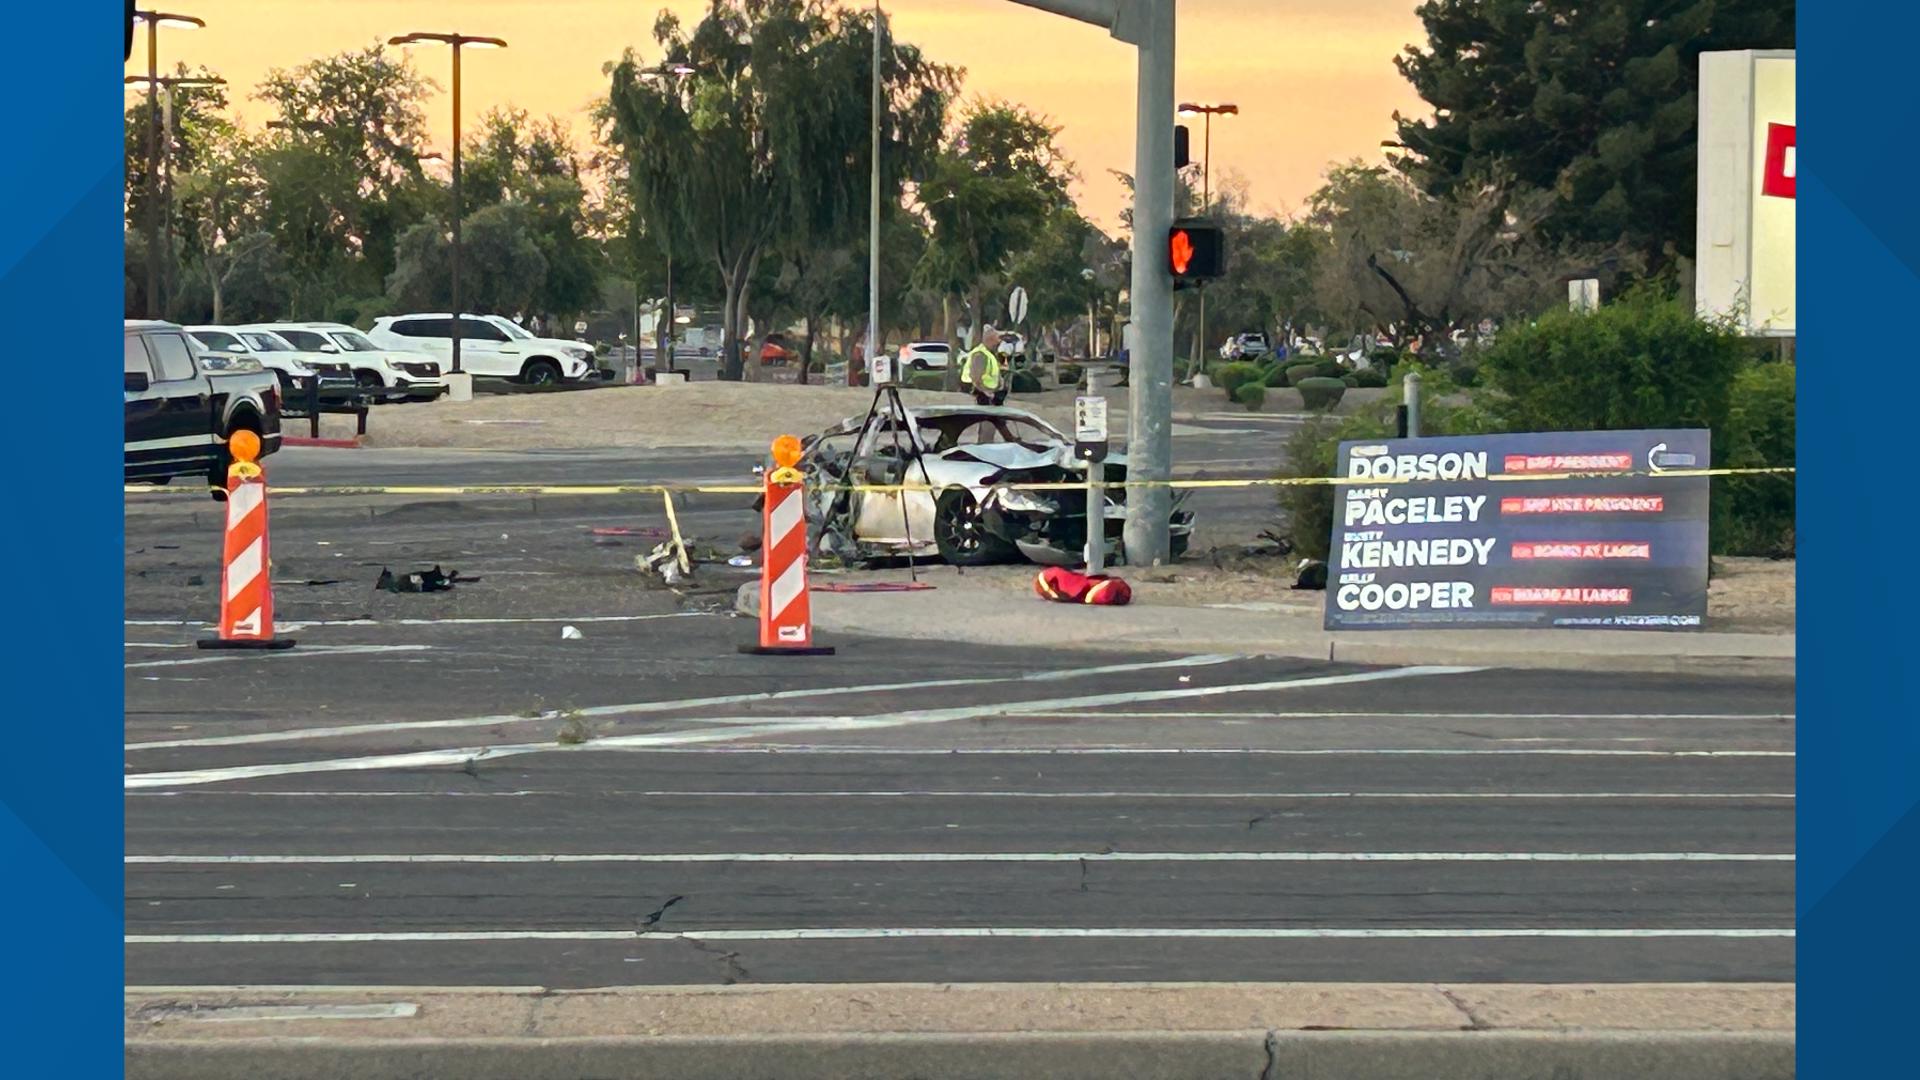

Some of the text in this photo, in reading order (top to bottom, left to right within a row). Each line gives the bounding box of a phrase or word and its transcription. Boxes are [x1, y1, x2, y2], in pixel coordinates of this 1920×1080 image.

[1349, 450, 1487, 480] DOBSON
[1345, 495, 1487, 527] PACELEY
[1340, 538, 1496, 569] KENNEDY
[1336, 581, 1476, 612] COOPER
